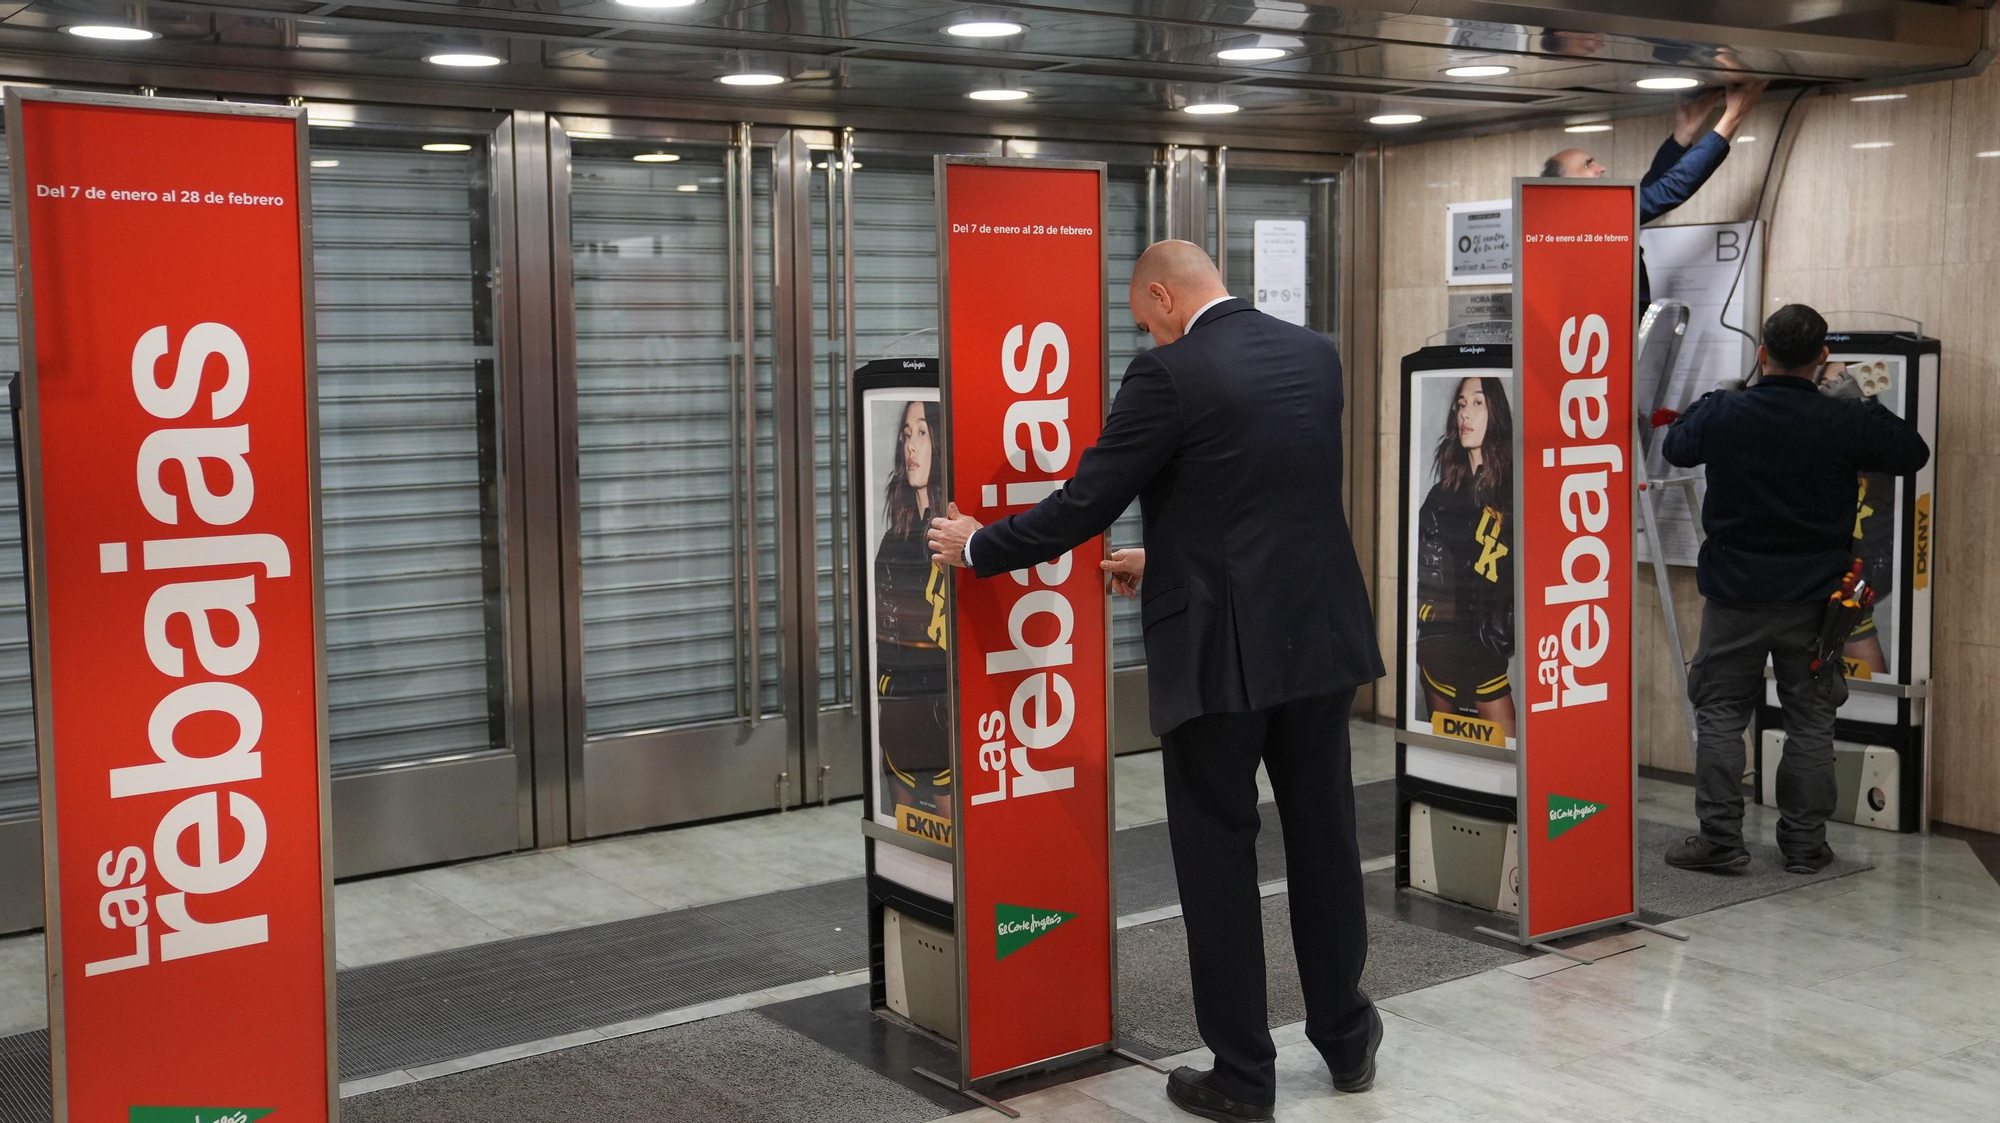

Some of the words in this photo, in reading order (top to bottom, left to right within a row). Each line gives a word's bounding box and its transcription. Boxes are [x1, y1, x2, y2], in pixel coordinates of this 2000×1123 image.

[36, 184, 65, 198] Del
[69, 185, 80, 199] 7
[84, 186, 107, 200] de
[110, 190, 158, 202] enero
[162, 190, 176, 203] al
[180, 190, 200, 204] 28
[204, 191, 225, 204] de
[228, 192, 284, 207] febrero
[952, 223, 969, 234] Del
[970, 223, 978, 234] 7
[979, 224, 992, 234] de
[993, 225, 1021, 235] enero
[1022, 225, 1031, 235] al
[1032, 225, 1045, 235] 28
[1046, 226, 1059, 235] de
[1060, 225, 1093, 236] febrero
[1525, 234, 1538, 243] Del
[1539, 234, 1544, 243] 7
[1545, 234, 1554, 243] de
[1555, 235, 1576, 243] enero
[1576, 234, 1583, 243] al
[1583, 234, 1593, 243] 28
[1593, 234, 1603, 243] de
[1603, 234, 1629, 243] febrero
[1715, 230, 1741, 263] B
[1465, 305, 1507, 314] COMERCIAL
[1470, 295, 1504, 304] HORARIO
[1543, 313, 1624, 708] rebajas
[1916, 508, 1928, 575] DKNY
[99, 321, 291, 963] rebajas
[1531, 634, 1559, 713] Las
[1443, 718, 1494, 742] DKNY
[970, 710, 1006, 806] Las
[906, 812, 952, 844] DKNY
[1549, 809, 1557, 821] El
[1557, 808, 1573, 820] Corte
[84, 845, 150, 978] Las
[997, 922, 1008, 936] El
[1008, 920, 1030, 934] Corte
